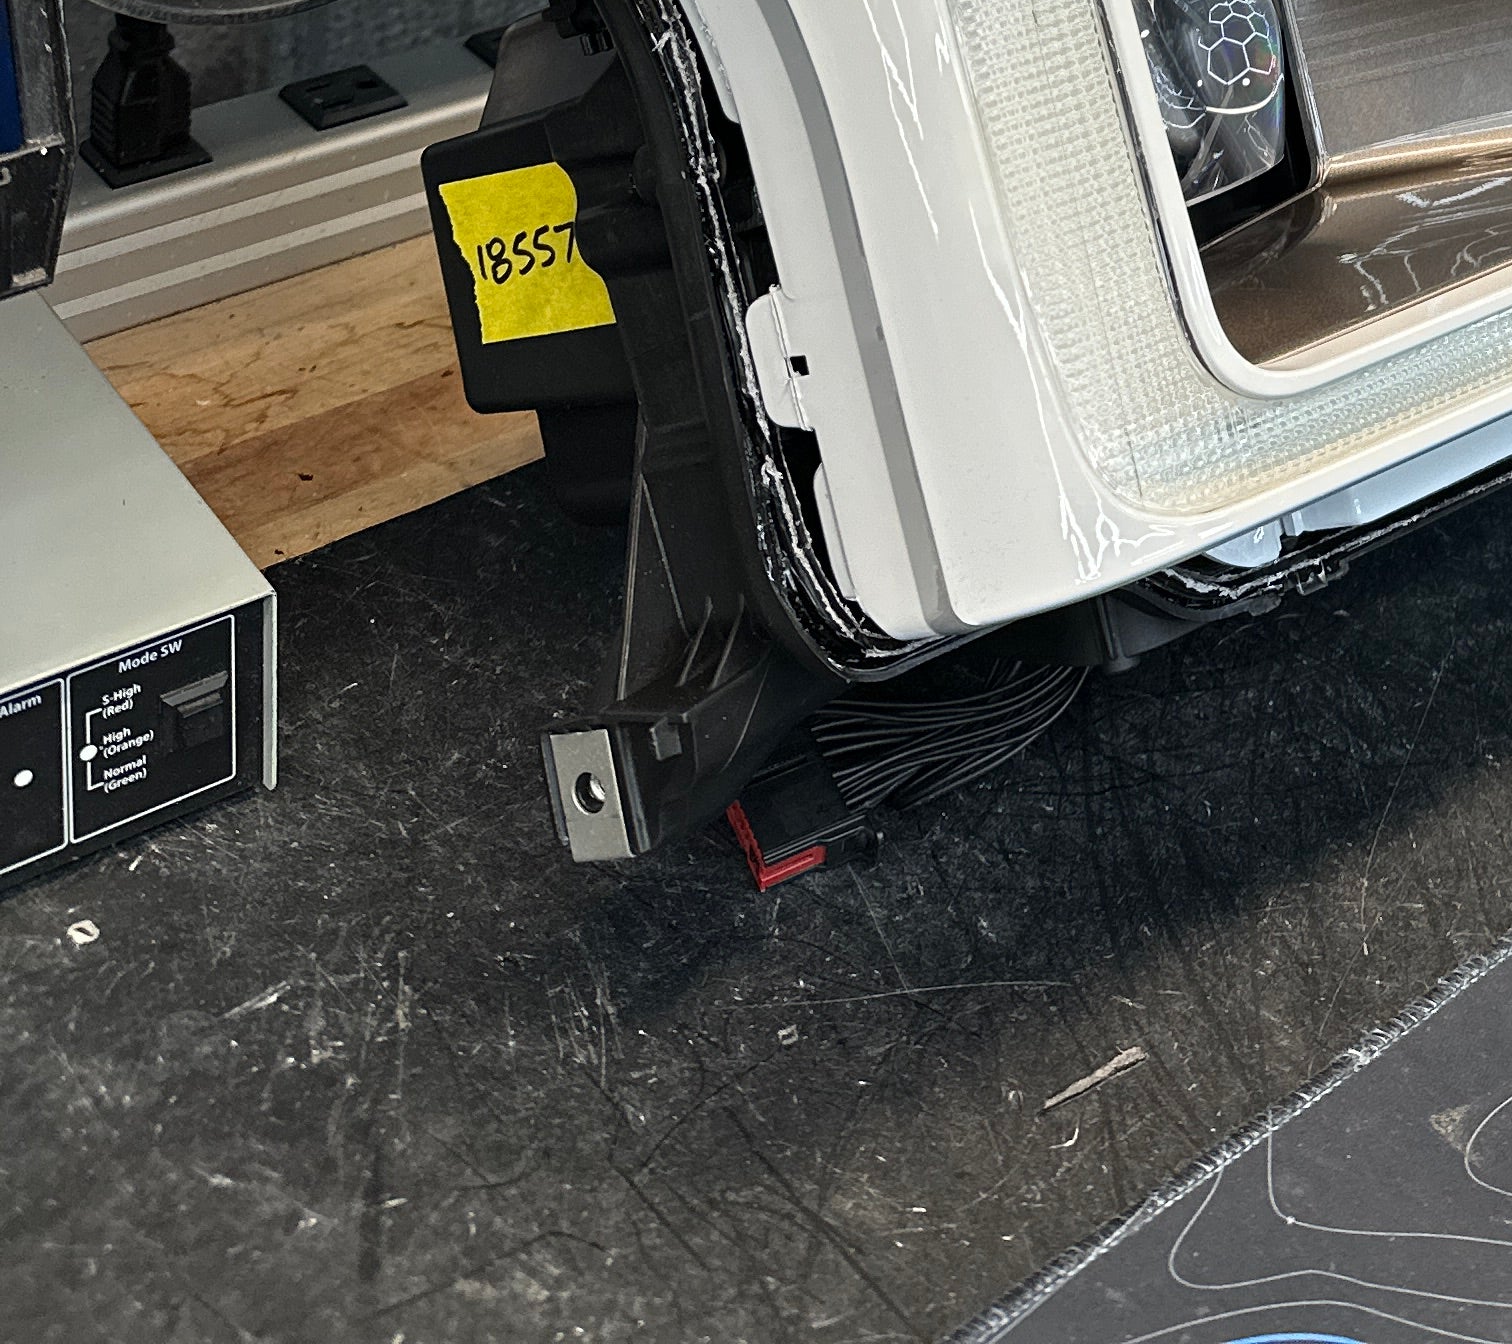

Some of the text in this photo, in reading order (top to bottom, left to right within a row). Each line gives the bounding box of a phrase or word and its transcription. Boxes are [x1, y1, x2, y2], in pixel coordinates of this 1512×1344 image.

[476, 221, 575, 285] 18557
[118, 639, 183, 674] Mode SW
[102, 683, 142, 706] S-High
[102, 698, 134, 720] (Red)
[103, 727, 132, 746] High
[103, 729, 155, 759] (Orange)
[103, 754, 147, 781] Normal
[103, 767, 148, 794] (Green)
